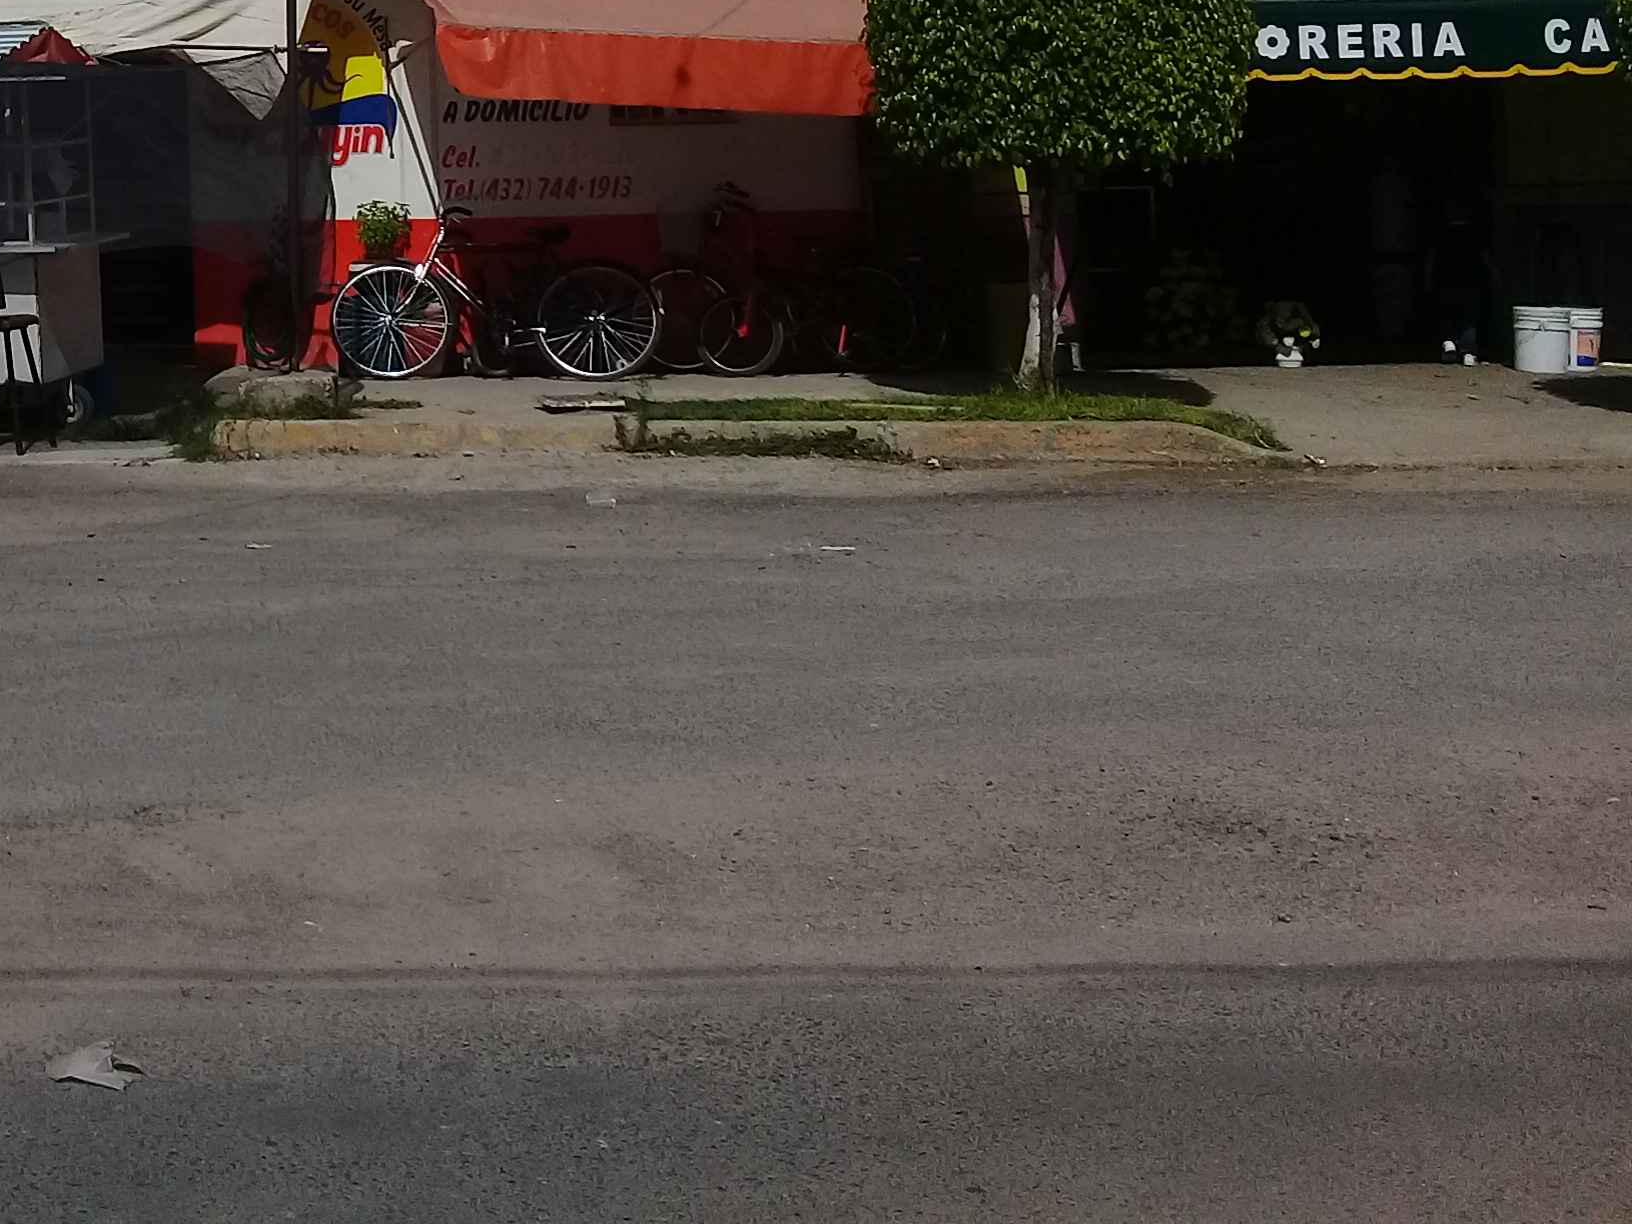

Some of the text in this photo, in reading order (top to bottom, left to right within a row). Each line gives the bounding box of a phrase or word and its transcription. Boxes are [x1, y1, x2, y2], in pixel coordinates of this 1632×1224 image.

[362, 7, 392, 51] Mesa
[1254, 21, 1466, 60] ORERIA
[442, 99, 591, 124] A DOMICILIO
[441, 144, 481, 169] Cel.
